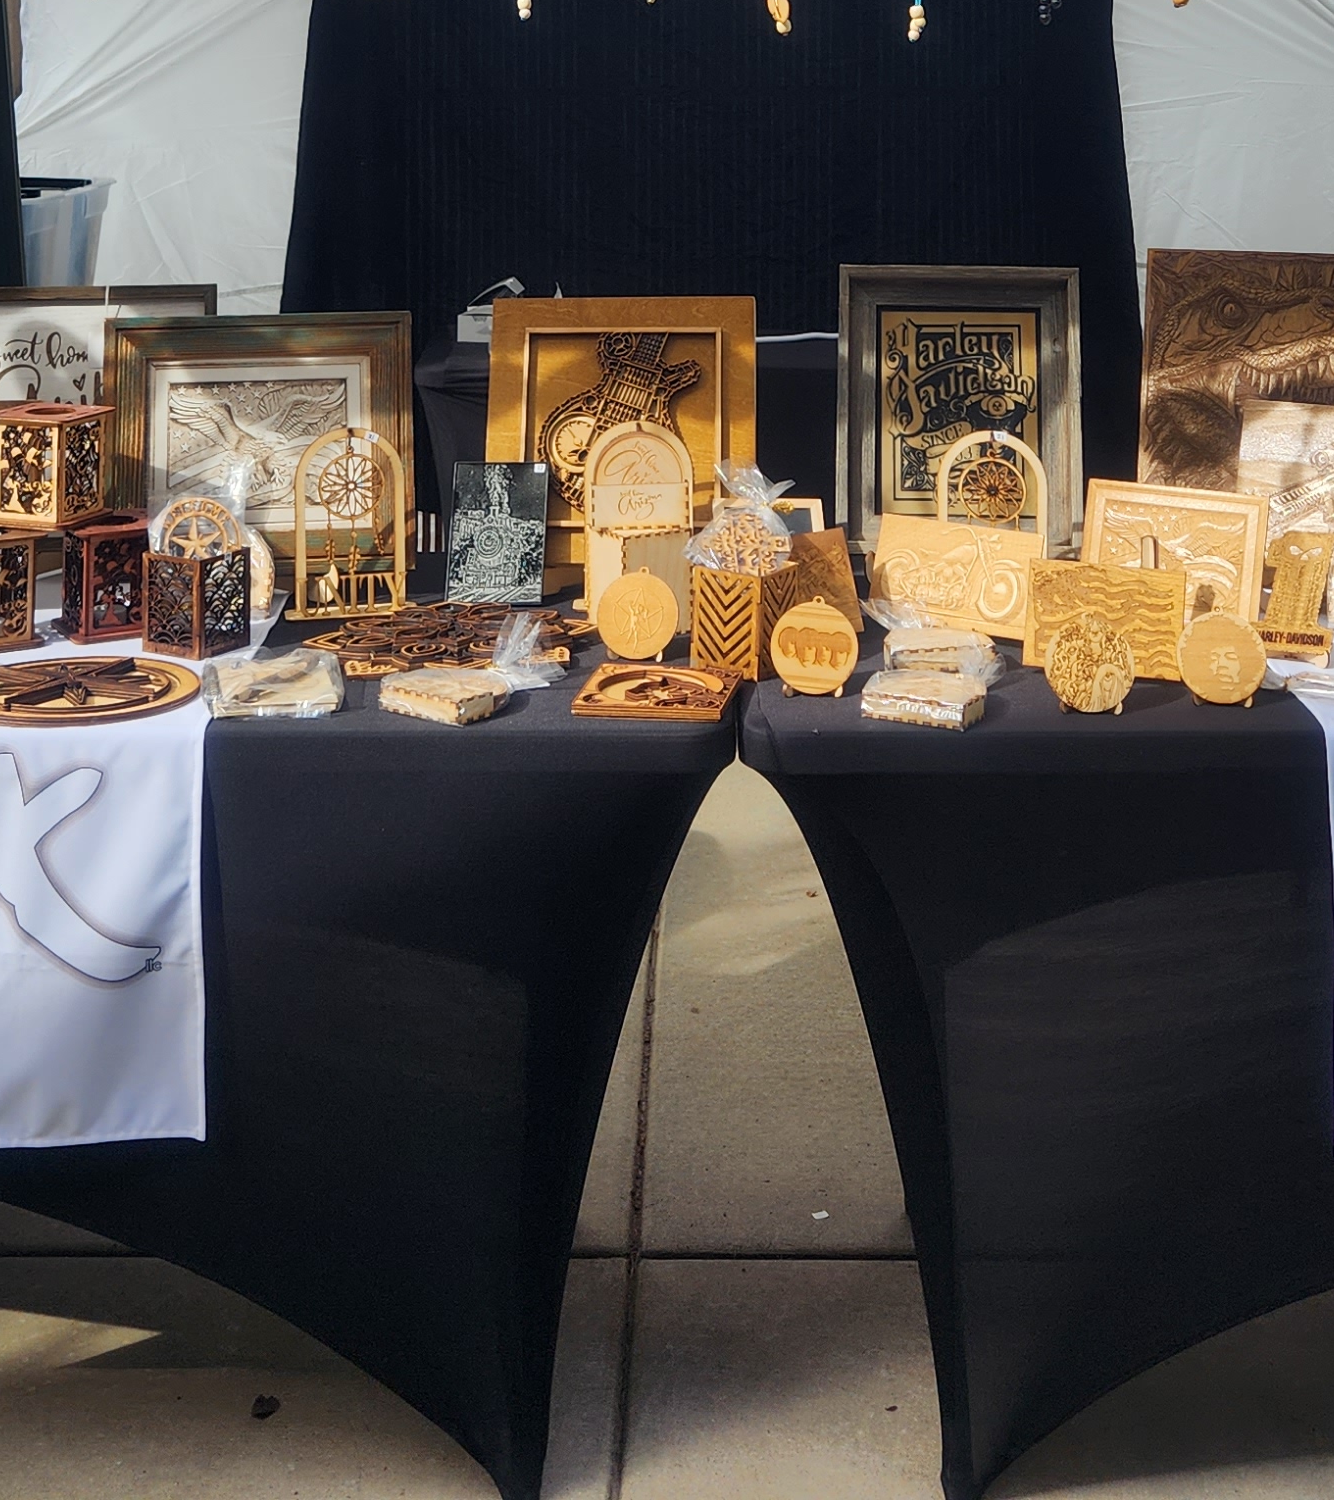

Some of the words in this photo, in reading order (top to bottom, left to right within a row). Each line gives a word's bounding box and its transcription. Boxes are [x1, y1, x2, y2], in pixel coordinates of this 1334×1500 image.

[46, 332, 88, 369] hom
[886, 317, 1013, 378] Harley
[887, 363, 1036, 435] Davidson
[921, 423, 964, 448] SINCE
[296, 571, 407, 618] UNITY
